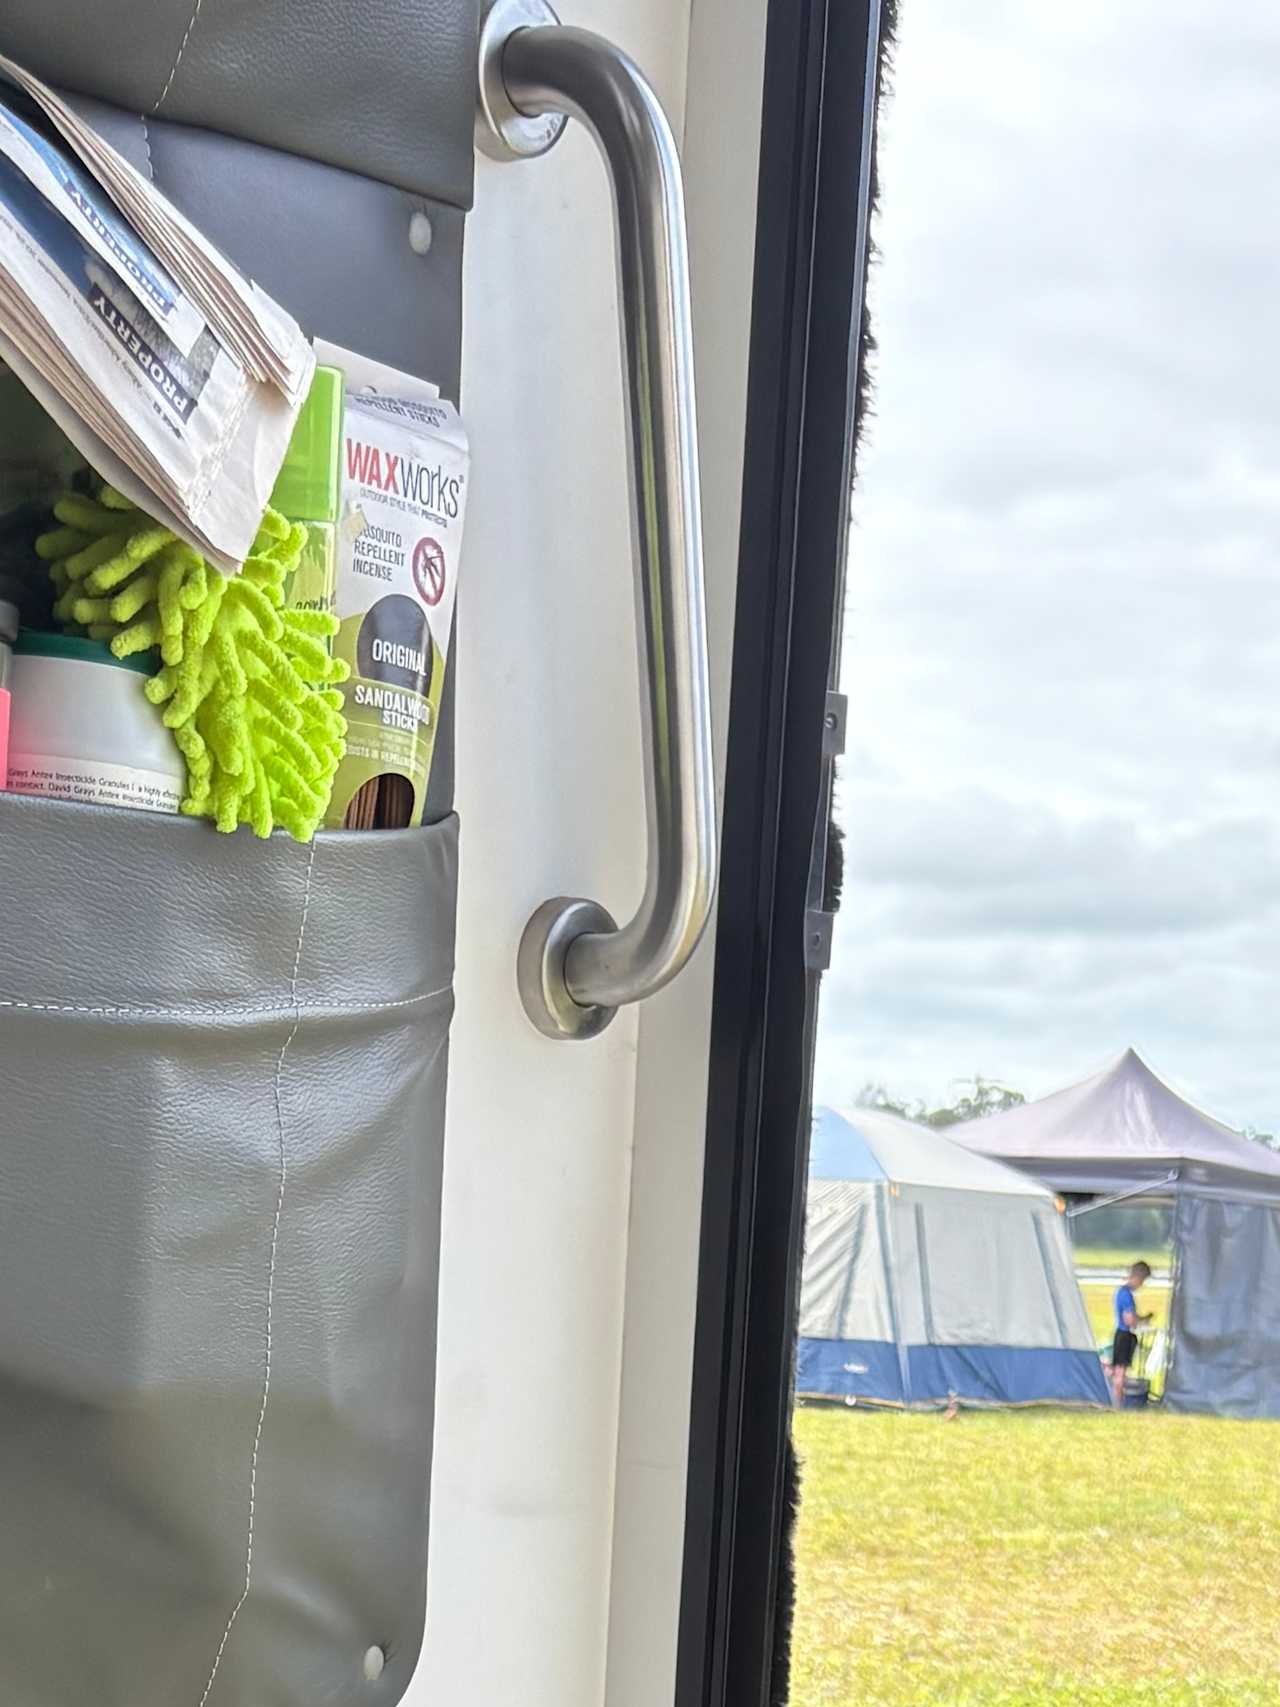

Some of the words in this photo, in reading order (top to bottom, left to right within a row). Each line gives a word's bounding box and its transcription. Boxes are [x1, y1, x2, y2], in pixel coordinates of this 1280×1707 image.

[94, 297, 188, 414] PROPERTY
[354, 539, 406, 567] REPELLENT
[352, 558, 394, 583] INCENSE
[372, 638, 427, 676] ORIGINAL
[48, 781, 71, 792] David
